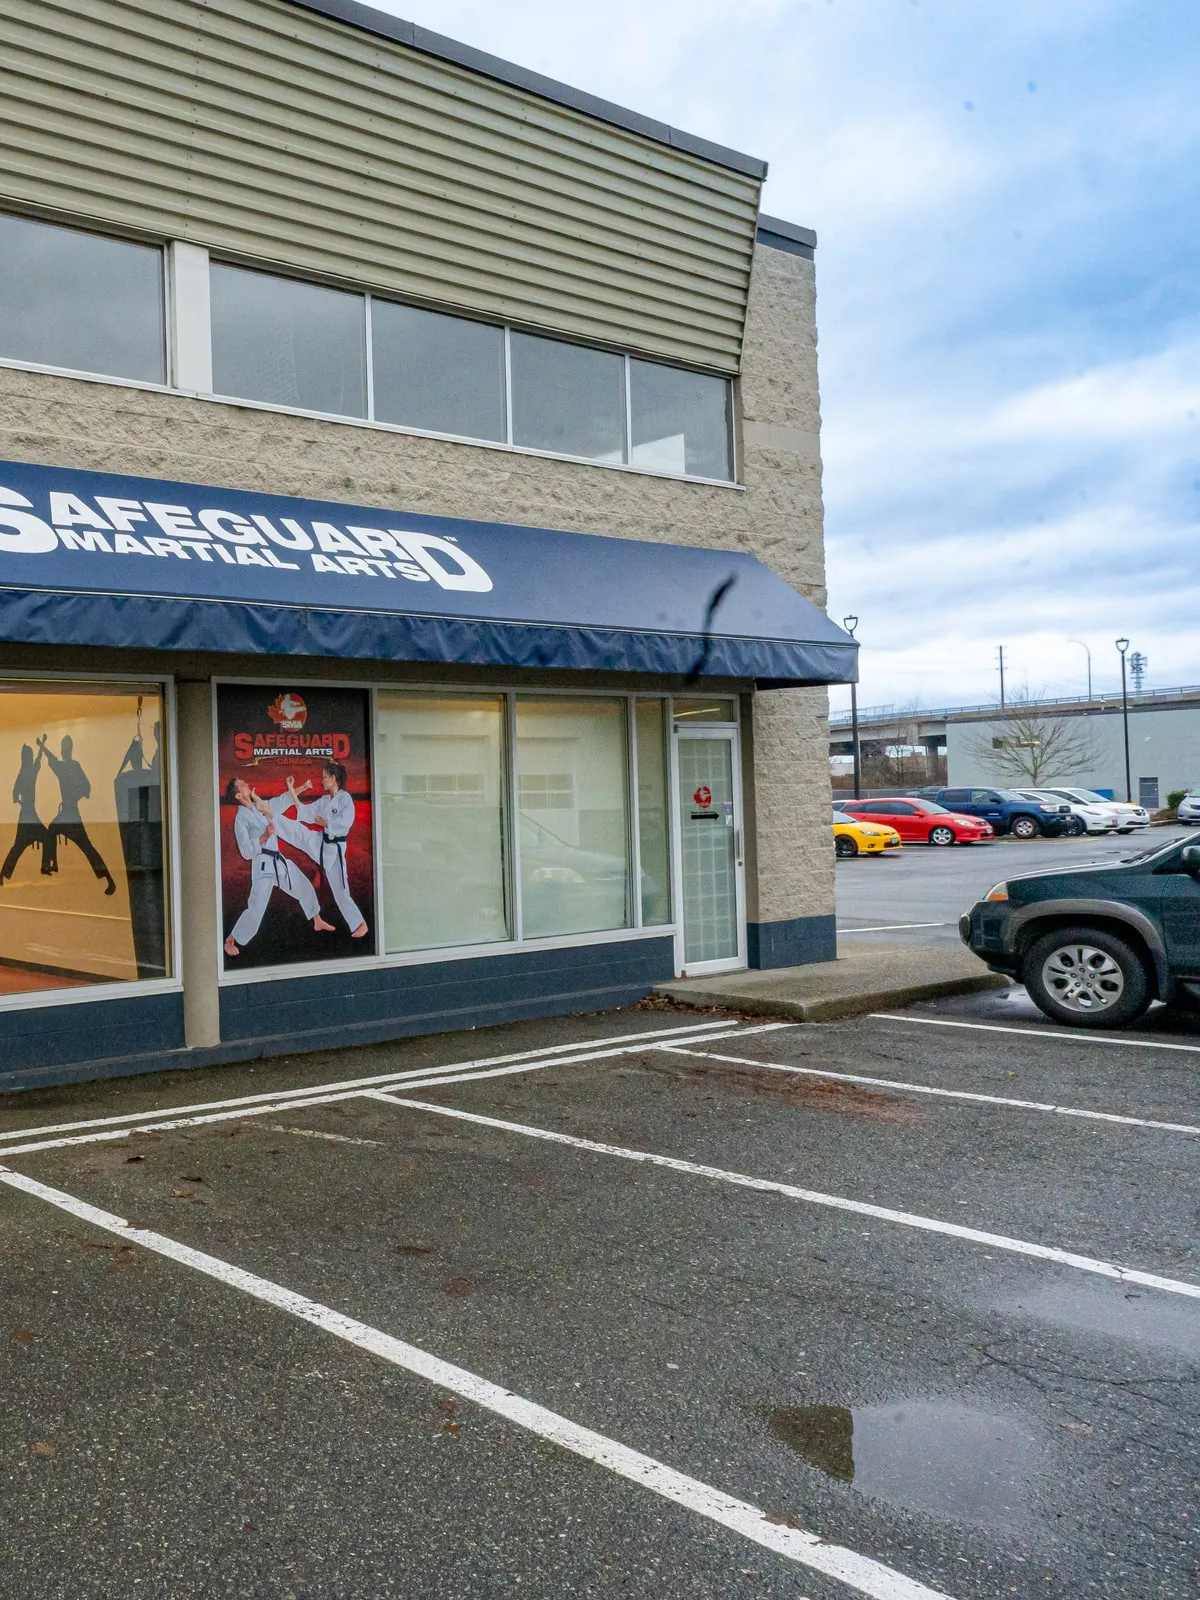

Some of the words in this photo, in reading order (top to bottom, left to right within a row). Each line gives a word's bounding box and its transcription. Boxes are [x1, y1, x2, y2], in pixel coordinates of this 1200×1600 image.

[54, 528, 300, 571] MARTIAL
[310, 553, 431, 582] ARTS
[282, 720, 303, 730] SMA
[234, 732, 351, 760] SAFEGUARD
[253, 748, 302, 756] MARTIAL
[305, 748, 334, 756] ARTS
[277, 757, 313, 765] CANADA
